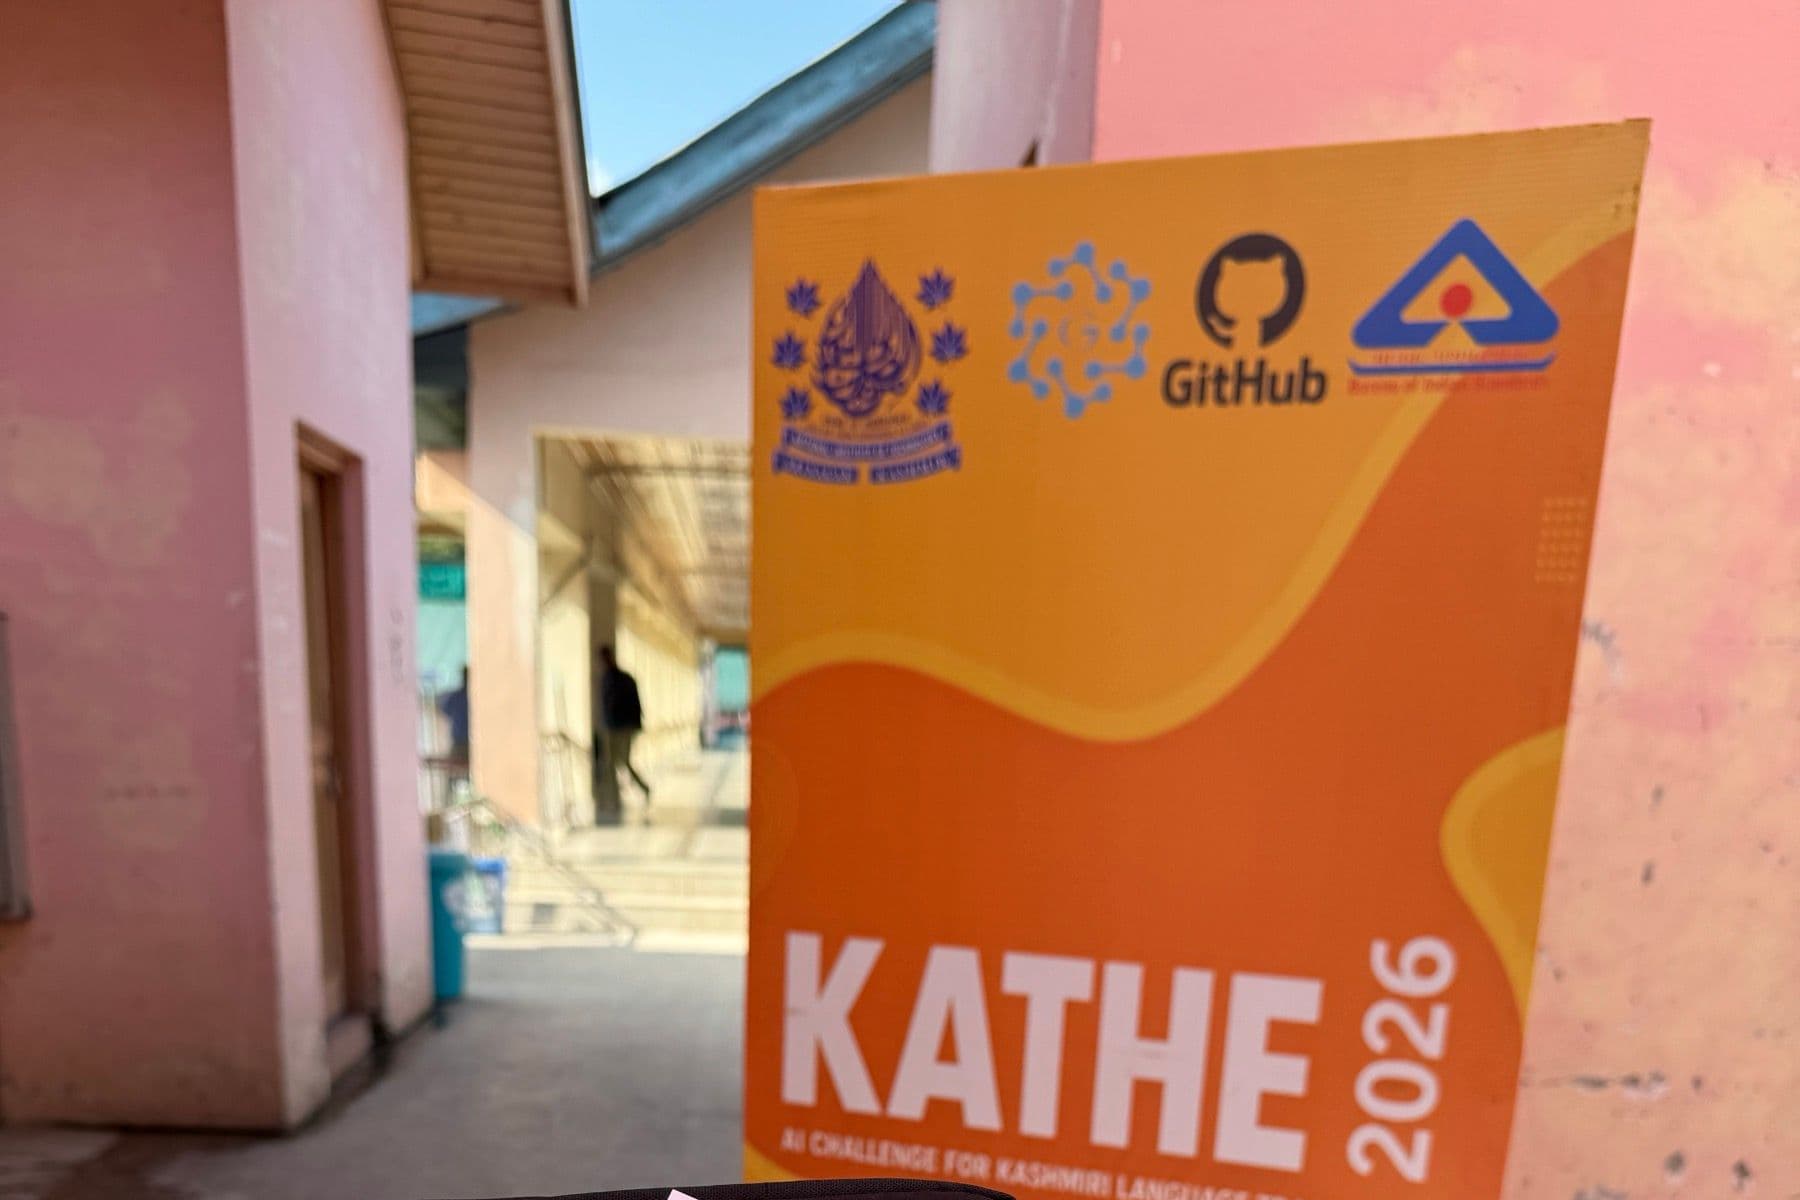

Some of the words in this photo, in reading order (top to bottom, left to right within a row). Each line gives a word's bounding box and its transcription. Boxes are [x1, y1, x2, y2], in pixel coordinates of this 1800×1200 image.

[1161, 356, 1328, 408] GitHub
[783, 930, 1323, 1172] KATHE
[1346, 935, 1456, 1184] 2026
[780, 1126, 805, 1152] AI
[809, 1130, 938, 1173] CHALLENGE
[943, 1149, 993, 1179] FOR
[996, 1156, 1110, 1197] KASHMIRI
